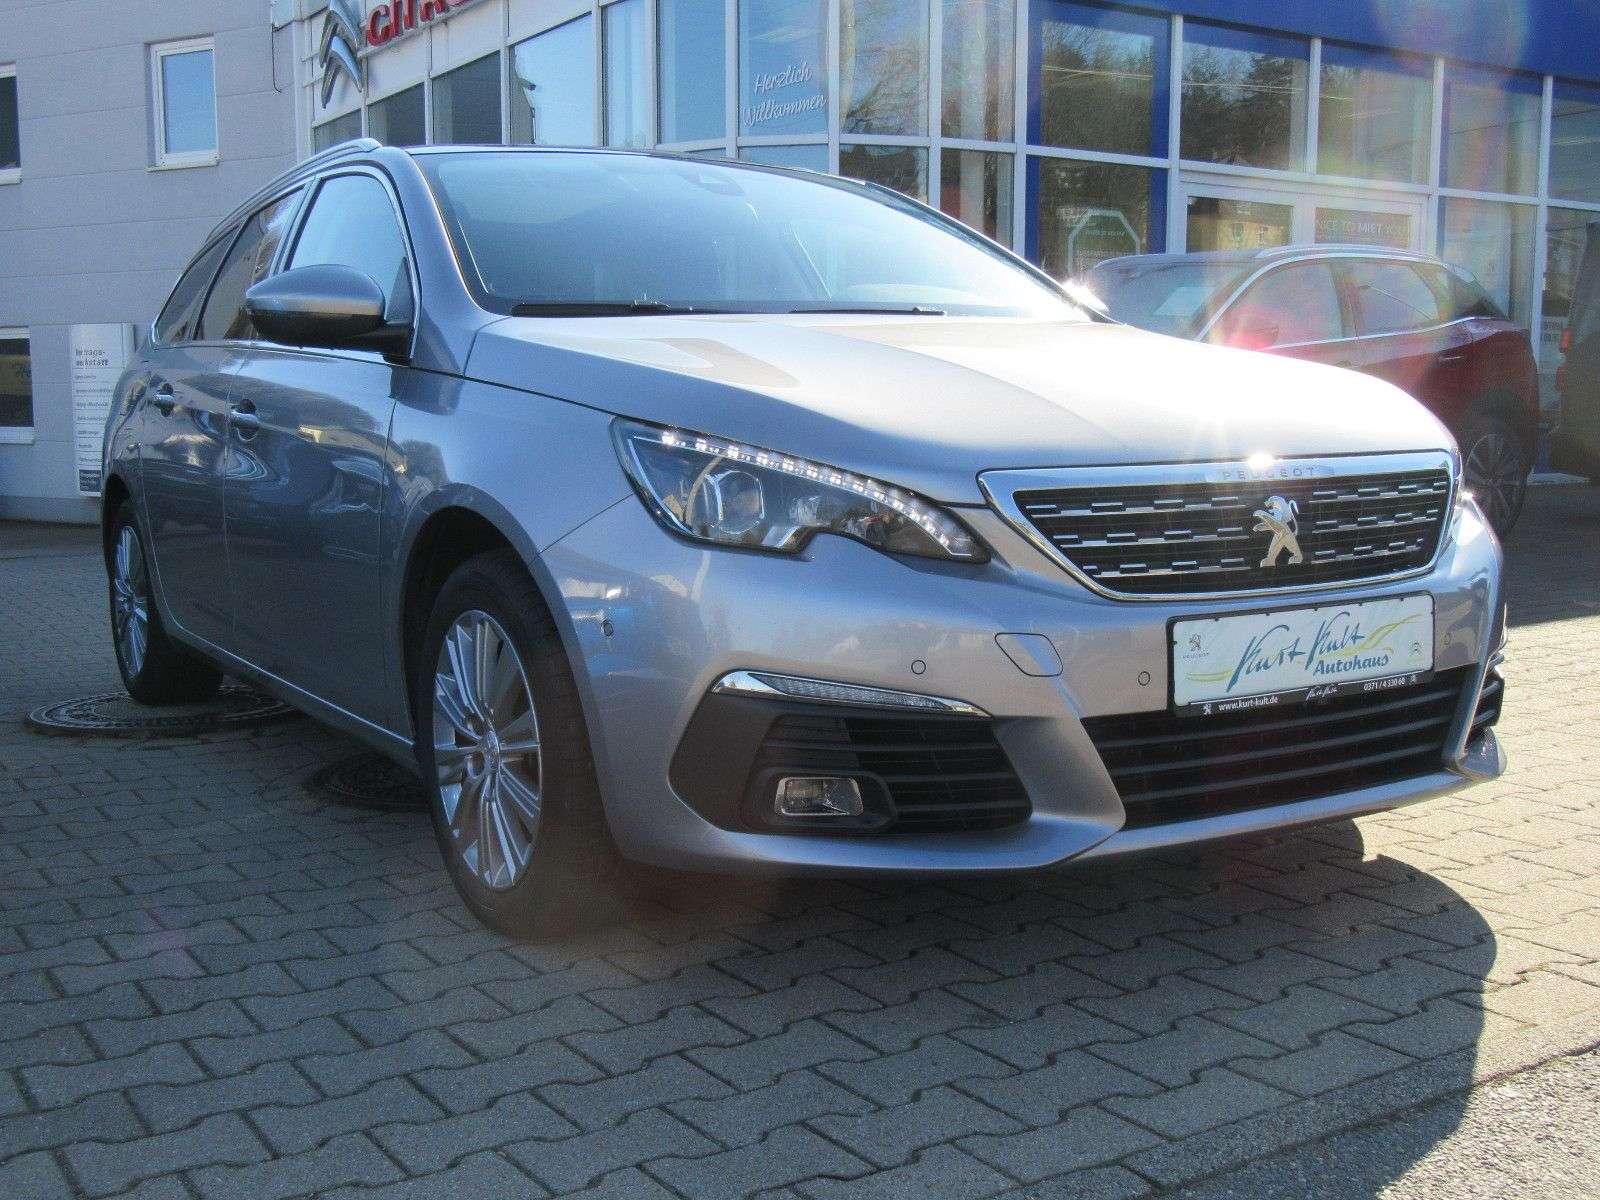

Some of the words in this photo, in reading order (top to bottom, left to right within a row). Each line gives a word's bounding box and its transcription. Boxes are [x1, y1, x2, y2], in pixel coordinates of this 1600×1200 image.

[366, 0, 473, 47] CITR
[754, 61, 813, 95] Herzlich
[743, 95, 828, 128] Willkommen
[1357, 222, 1383, 236] MIET
[1222, 466, 1314, 480] PEUGEOT
[1226, 624, 1306, 693] Kurt
[1305, 611, 1365, 670] Kult
[1312, 653, 1390, 676] Autohaus
[1218, 696, 1279, 711] www.kurt-kult.de
